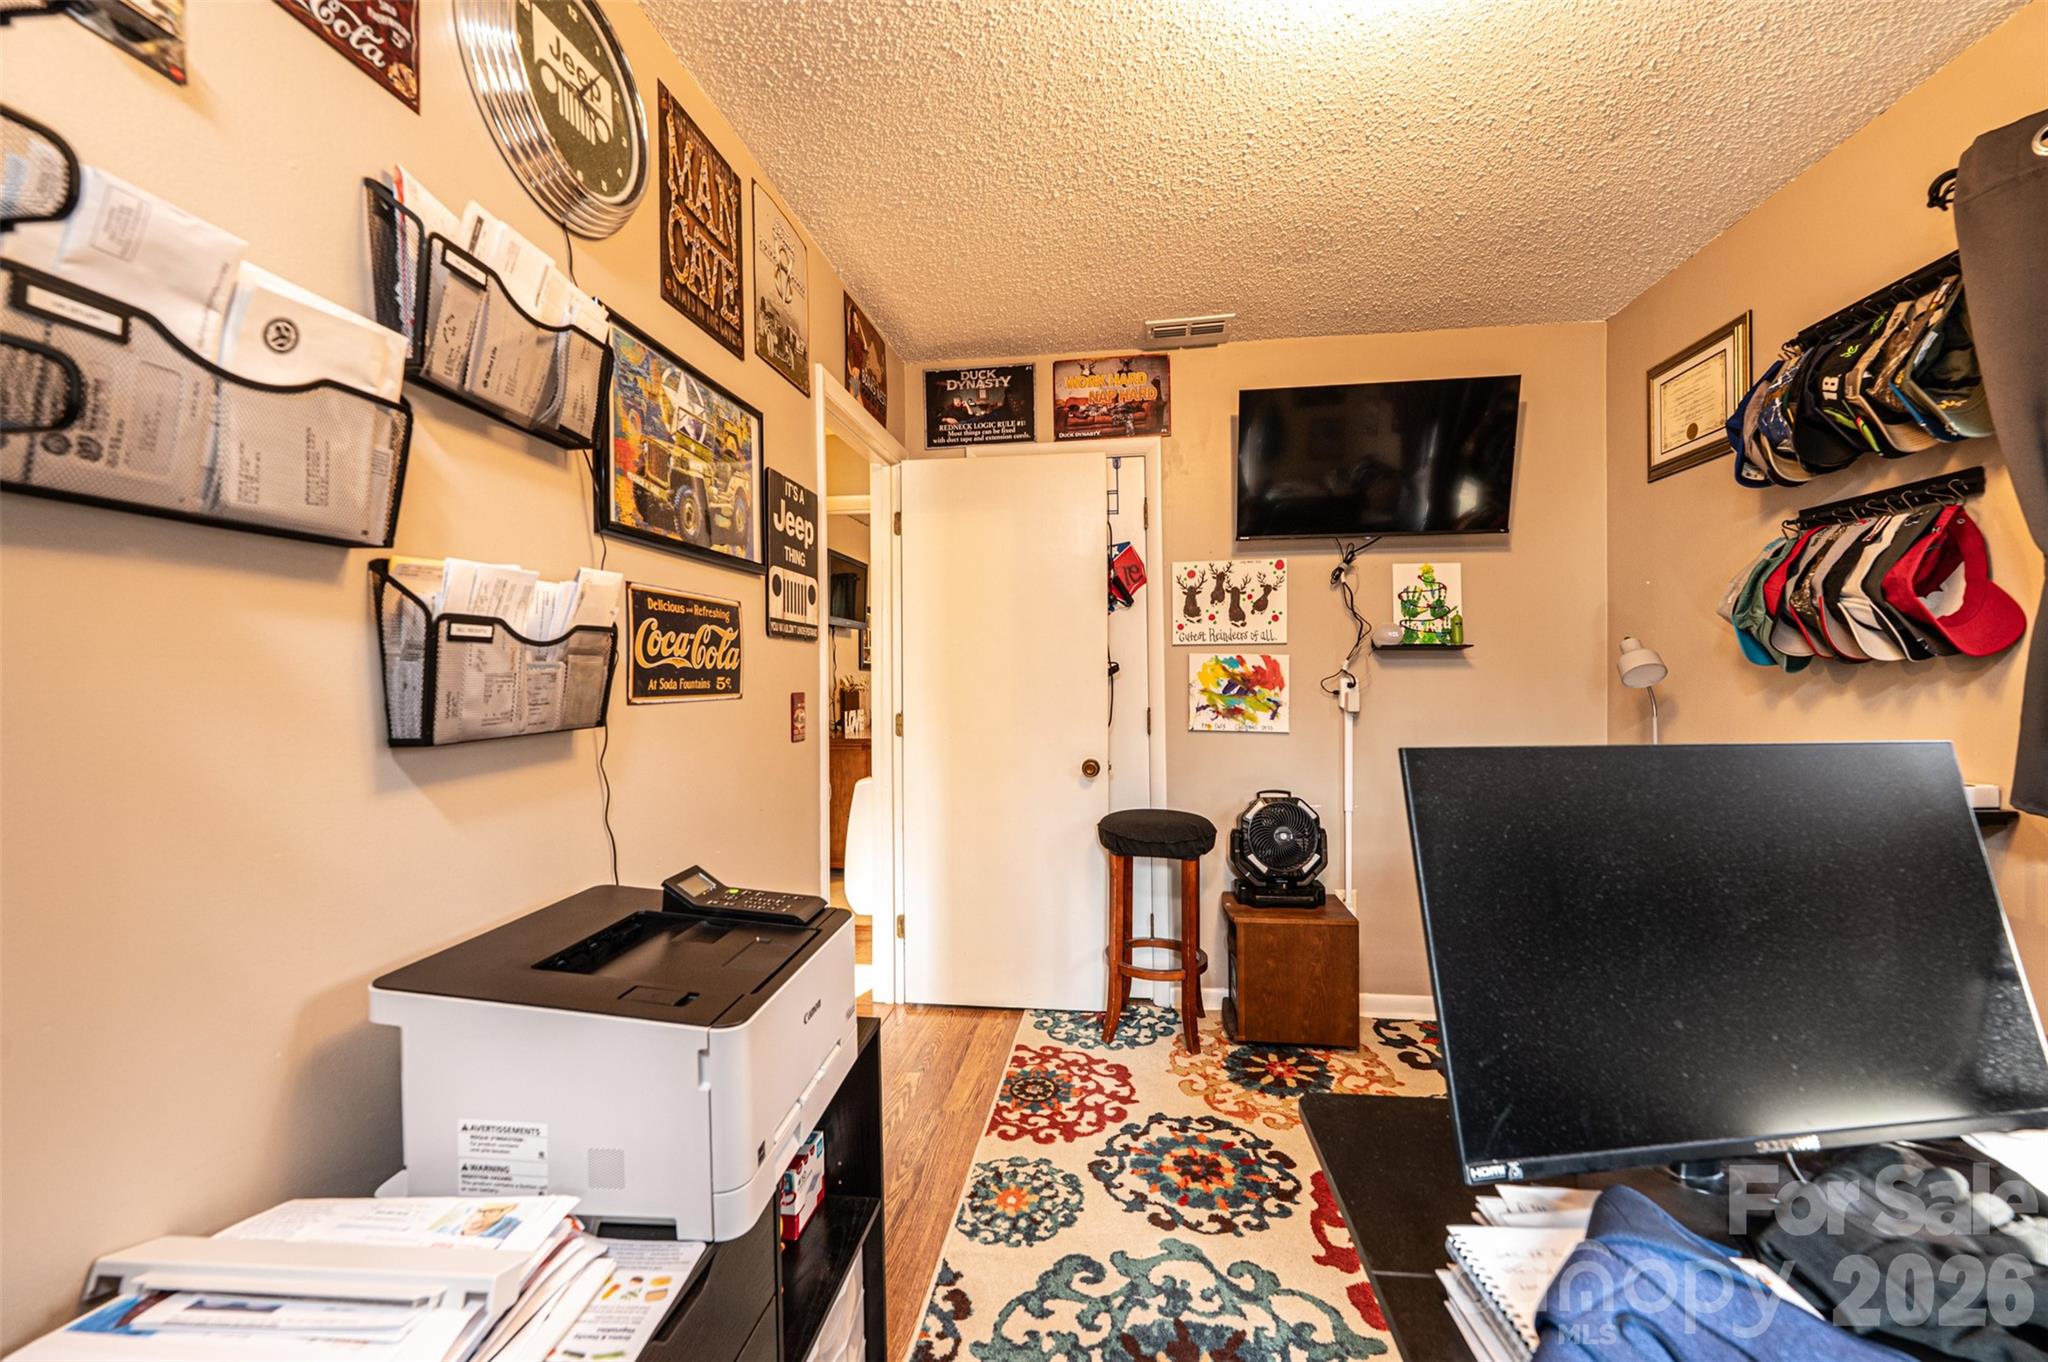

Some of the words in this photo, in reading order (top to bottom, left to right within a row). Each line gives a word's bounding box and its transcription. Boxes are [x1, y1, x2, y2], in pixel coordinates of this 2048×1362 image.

[549, 35, 602, 104] Jeep
[666, 112, 739, 266] MAN
[668, 203, 741, 332] CAVE
[946, 375, 1012, 391] DYNASTY
[960, 369, 997, 380] DUCK
[1065, 374, 1107, 389] WORK
[1108, 371, 1148, 387] HARD
[1088, 390, 1117, 405] NAP
[1119, 386, 1158, 402] HARD
[939, 423, 972, 431] REDNECK
[997, 420, 1016, 428] RULE
[963, 429, 980, 437] things
[784, 480, 798, 502] IT'S
[799, 490, 805, 505] A
[773, 499, 814, 549] Jeep
[784, 545, 806, 567] THING
[647, 597, 686, 614] Delicious
[693, 604, 730, 623] Refreshing
[634, 617, 740, 670] Coca-Cola
[1208, 627, 1249, 642] Reindeers
[1250, 630, 1259, 643] of
[648, 679, 657, 690] At
[659, 678, 678, 690] Soda
[679, 677, 711, 689] Fountains
[803, 998, 822, 1025] Canon
[470, 1124, 541, 1136] AVERTISSEMENTS
[470, 1164, 510, 1174] WARNING
